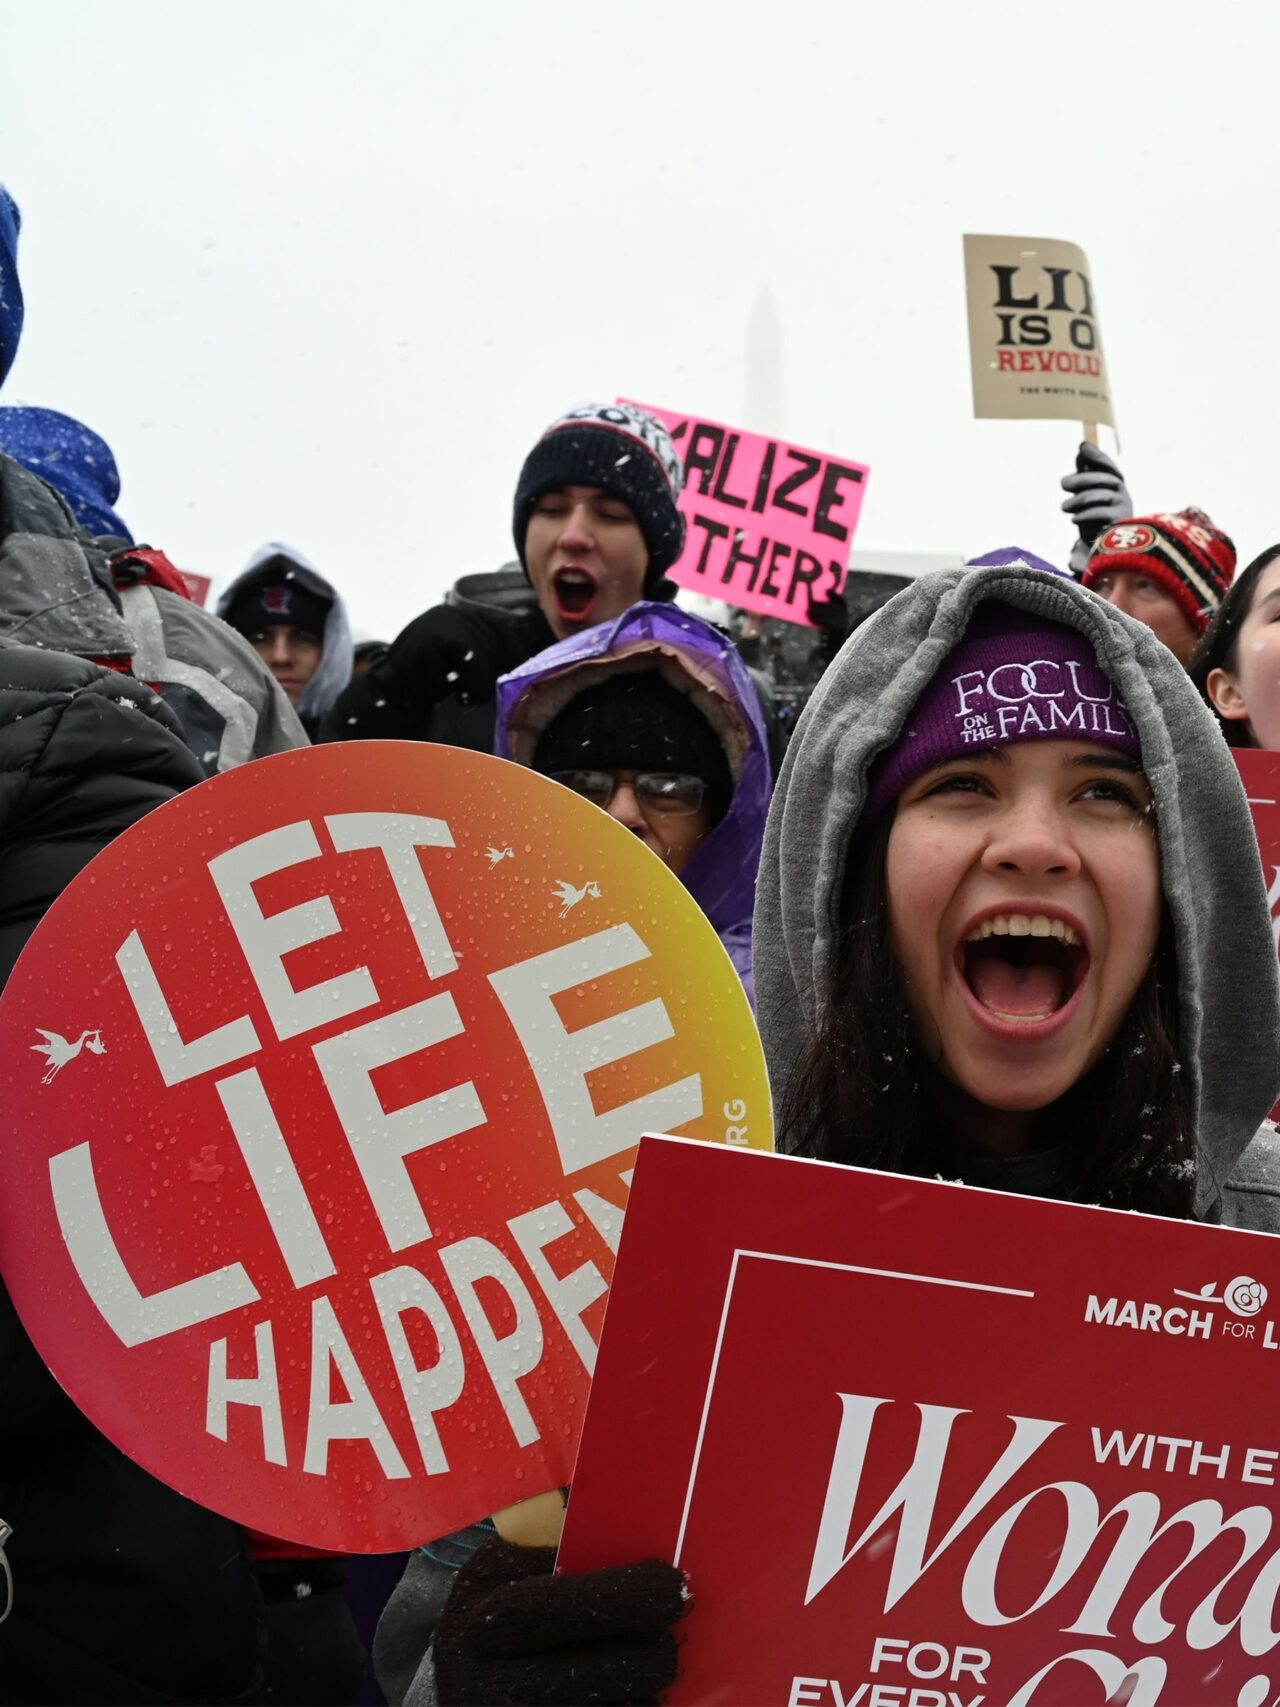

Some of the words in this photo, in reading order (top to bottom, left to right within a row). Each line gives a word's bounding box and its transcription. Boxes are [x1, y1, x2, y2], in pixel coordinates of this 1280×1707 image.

[995, 313, 1051, 346] IS
[951, 660, 1127, 718] FOCU
[960, 725, 998, 743] THE
[963, 712, 989, 731] ON
[115, 812, 458, 1088] LET
[48, 921, 704, 1349] LIFE
[1084, 1294, 1214, 1340] MARCH
[1222, 1320, 1256, 1340] FOR
[1091, 1426, 1231, 1480] WITH
[870, 1637, 992, 1685] FOR
